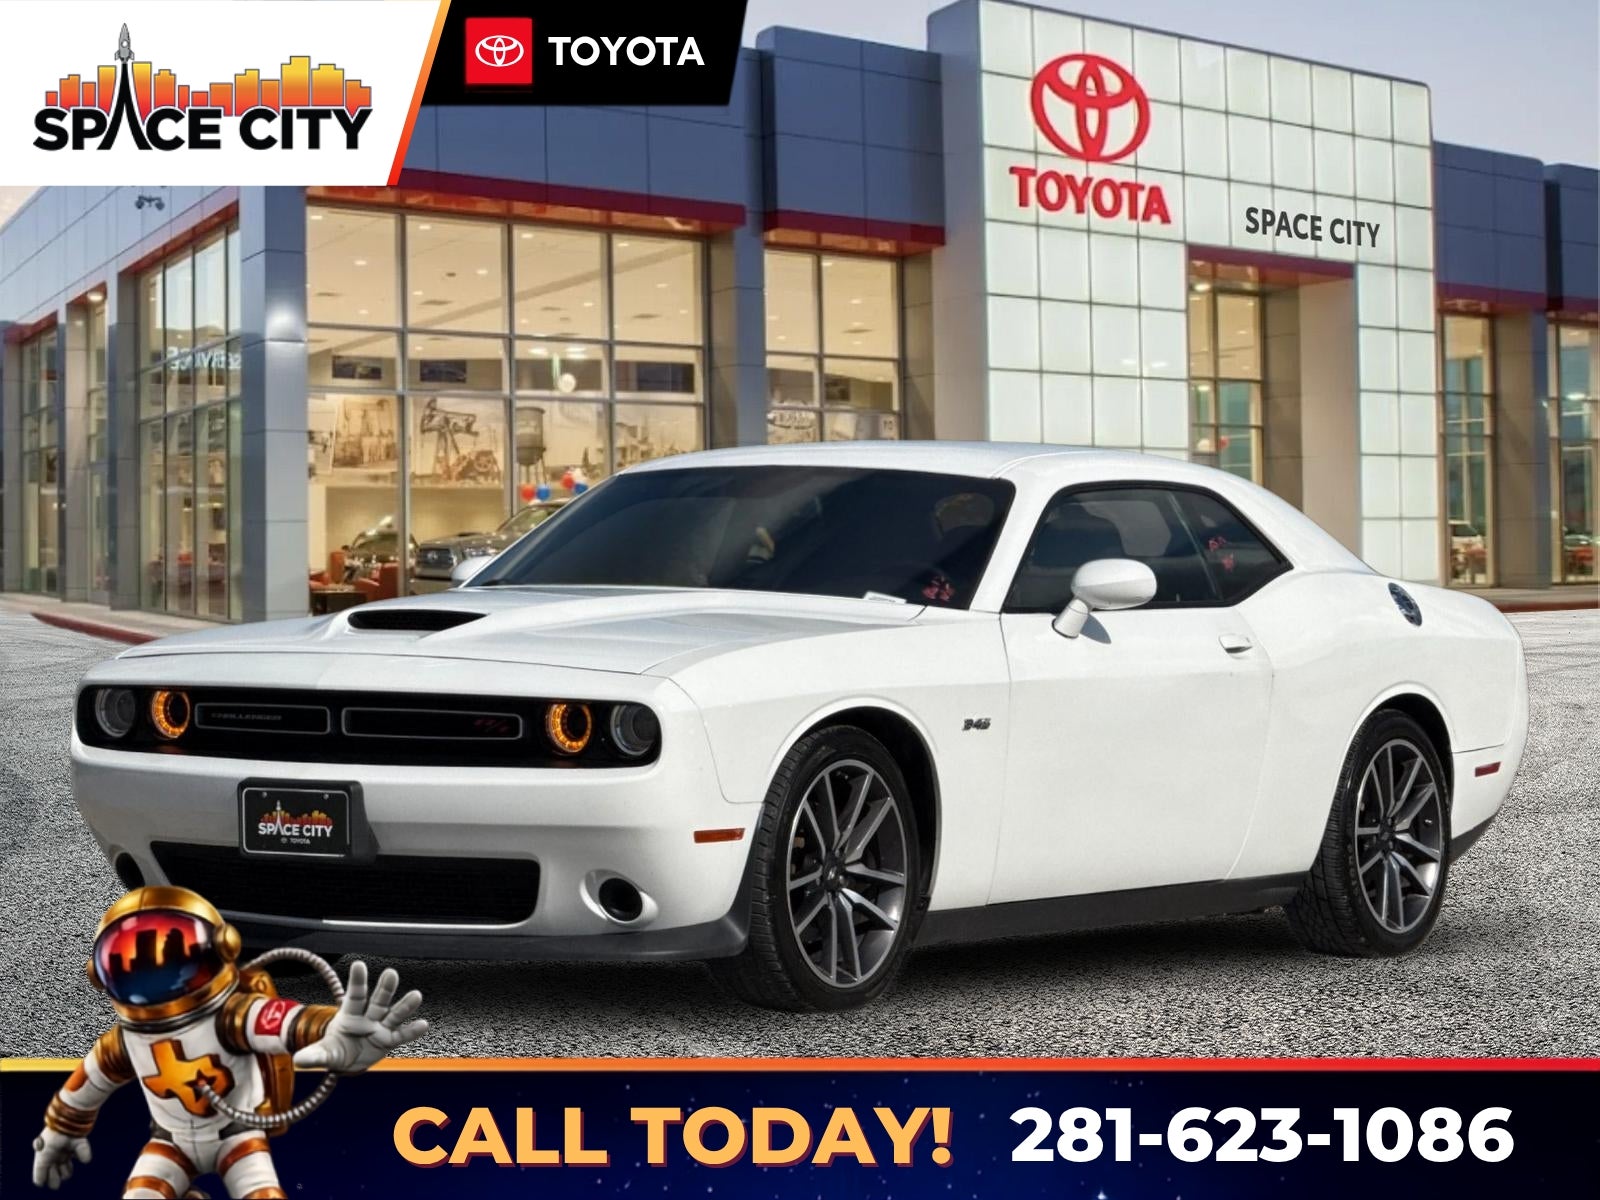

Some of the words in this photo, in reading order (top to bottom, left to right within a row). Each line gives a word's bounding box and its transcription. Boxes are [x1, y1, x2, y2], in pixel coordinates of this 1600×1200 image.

[1008, 166, 1172, 225] TOYOTA
[1245, 207, 1322, 242] SPACE
[1329, 218, 1381, 248] CITY
[258, 820, 300, 836] SPACE
[302, 824, 334, 838] CITY
